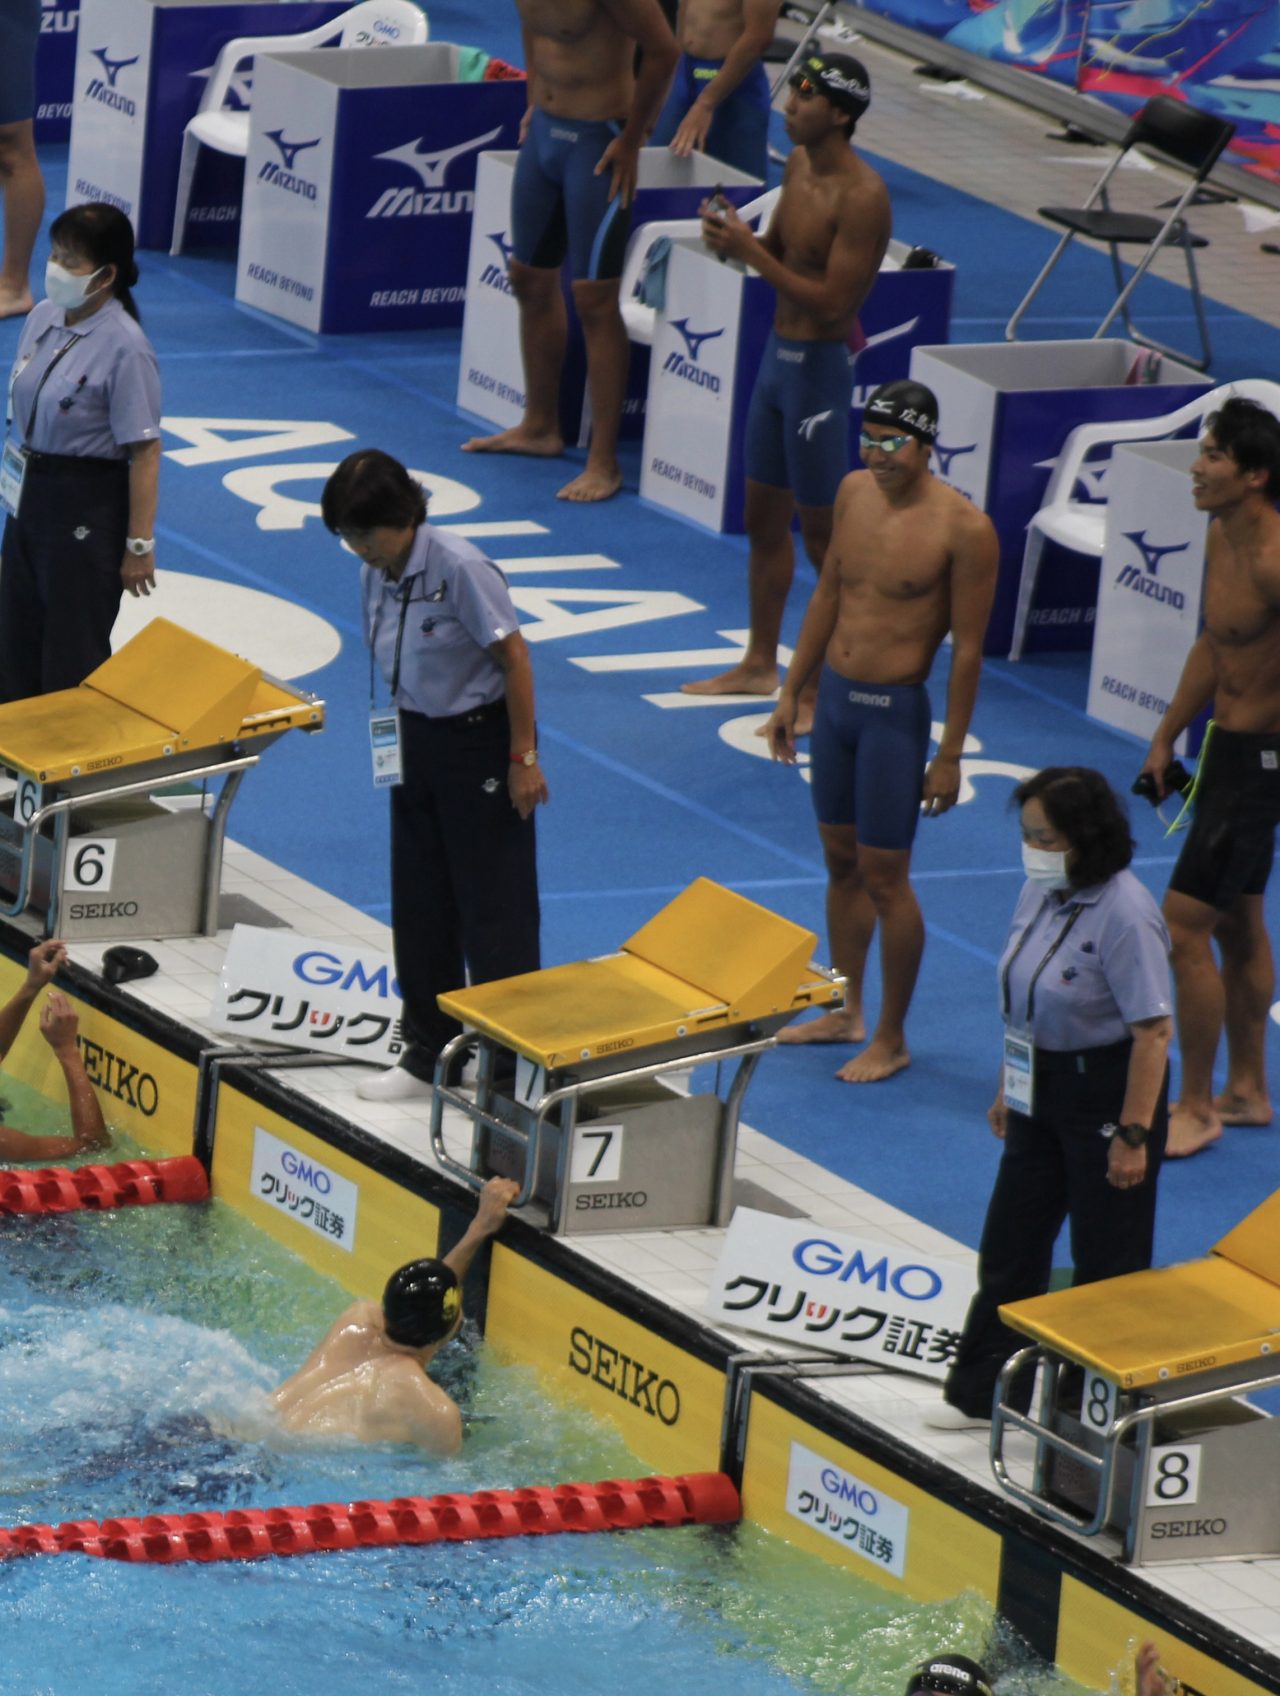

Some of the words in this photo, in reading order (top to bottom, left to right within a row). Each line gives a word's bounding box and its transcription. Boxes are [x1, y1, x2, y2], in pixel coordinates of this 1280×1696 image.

[36, 102, 72, 120] BEYO
[85, 78, 136, 117] MIZUNO
[258, 160, 318, 201] MIZUNO
[365, 186, 476, 218] MIZUN
[247, 262, 278, 289] REACH
[278, 275, 315, 302] BEYOND
[370, 288, 420, 307] REACH
[421, 285, 467, 305] BEYON
[467, 368, 496, 394] REACH
[662, 351, 721, 394] MIZUNO
[650, 457, 682, 484] REACH
[683, 471, 717, 500] BEYOND
[1116, 563, 1186, 612] MIZUNO
[848, 690, 891, 708] arena
[1100, 674, 1137, 706] REACH
[1138, 688, 1170, 716] BEYO
[86, 755, 124, 772] SEIKO
[20, 780, 37, 823] 6
[73, 843, 106, 887] 6
[69, 901, 139, 920] SEIKO
[292, 950, 404, 1001] GM
[596, 1038, 635, 1055] SEIKO
[76, 1034, 159, 1117] EIKO
[522, 1056, 539, 1101] 7
[280, 1150, 332, 1195] GMO
[582, 1131, 613, 1177] 7
[261, 1172, 345, 1240] クリック証券
[575, 1190, 648, 1211] SEIKO
[792, 1238, 943, 1301] GMO
[723, 1275, 962, 1367] クリック証券
[568, 1326, 681, 1427] SEIKO
[1175, 1356, 1217, 1374] SEIKO
[1087, 1376, 1110, 1427] 8
[821, 1467, 878, 1516] GMO
[1154, 1451, 1190, 1500] 8
[798, 1490, 894, 1564] クリック証券
[1150, 1517, 1228, 1540] SEIKO
[929, 1663, 970, 1681] arena
